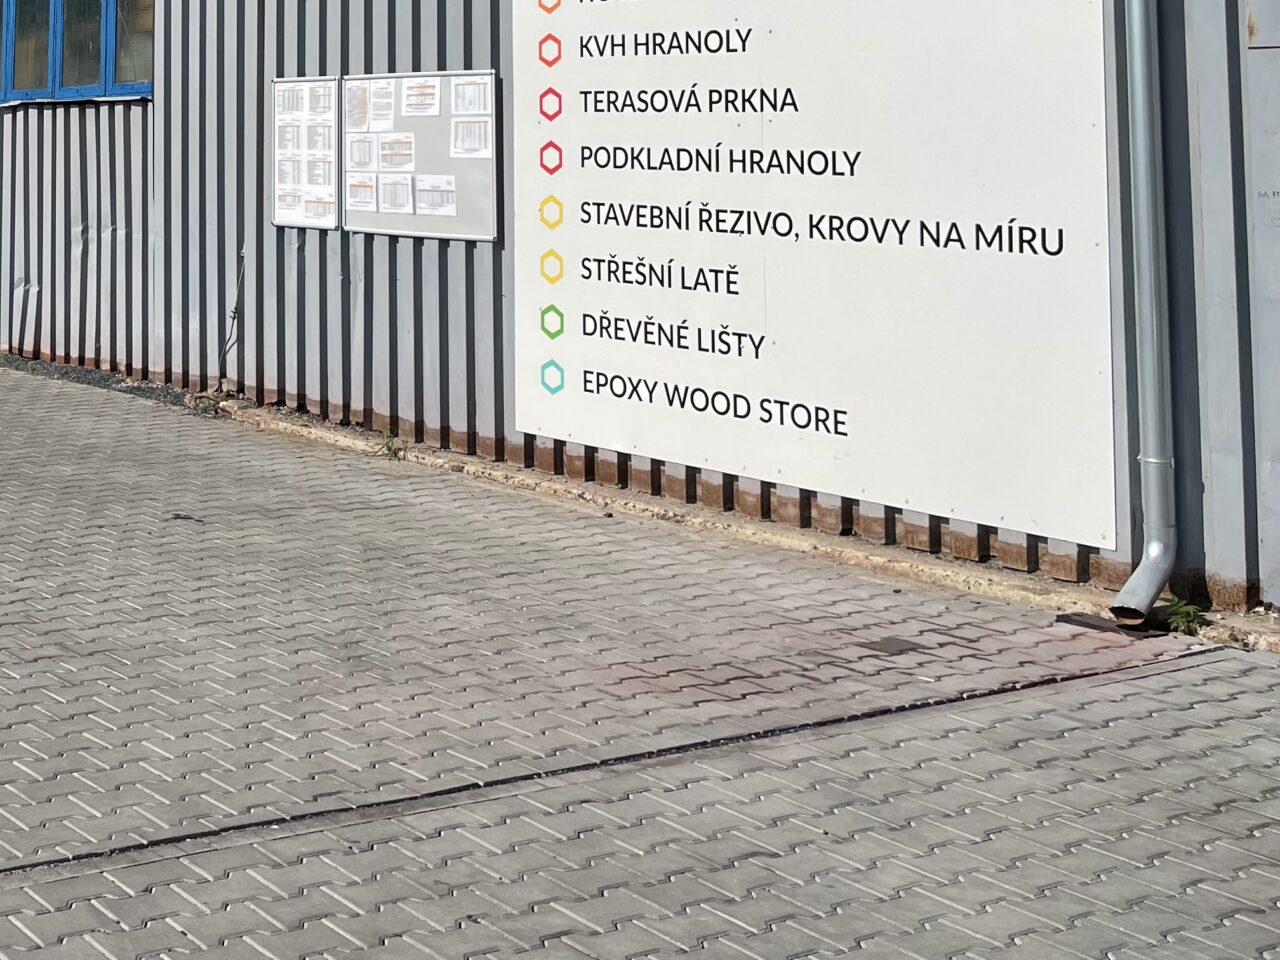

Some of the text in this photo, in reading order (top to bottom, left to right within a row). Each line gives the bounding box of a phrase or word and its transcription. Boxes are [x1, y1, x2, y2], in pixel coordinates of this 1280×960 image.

[579, 28, 753, 58] KVH HRANOLY
[579, 82, 799, 113] TERASOVÁ PRKNA
[580, 142, 862, 177] PODKLADNÍ HRANOLY
[580, 200, 1064, 257] STAVEBNÍ ŘEZIVO, KROVY NA MÍRU
[581, 253, 740, 296] STŘEŠNÍ LATĚ
[582, 309, 766, 360] DŘEVĚNÉ LIŠTY
[583, 369, 848, 437] EPOXY WOOD STORE
